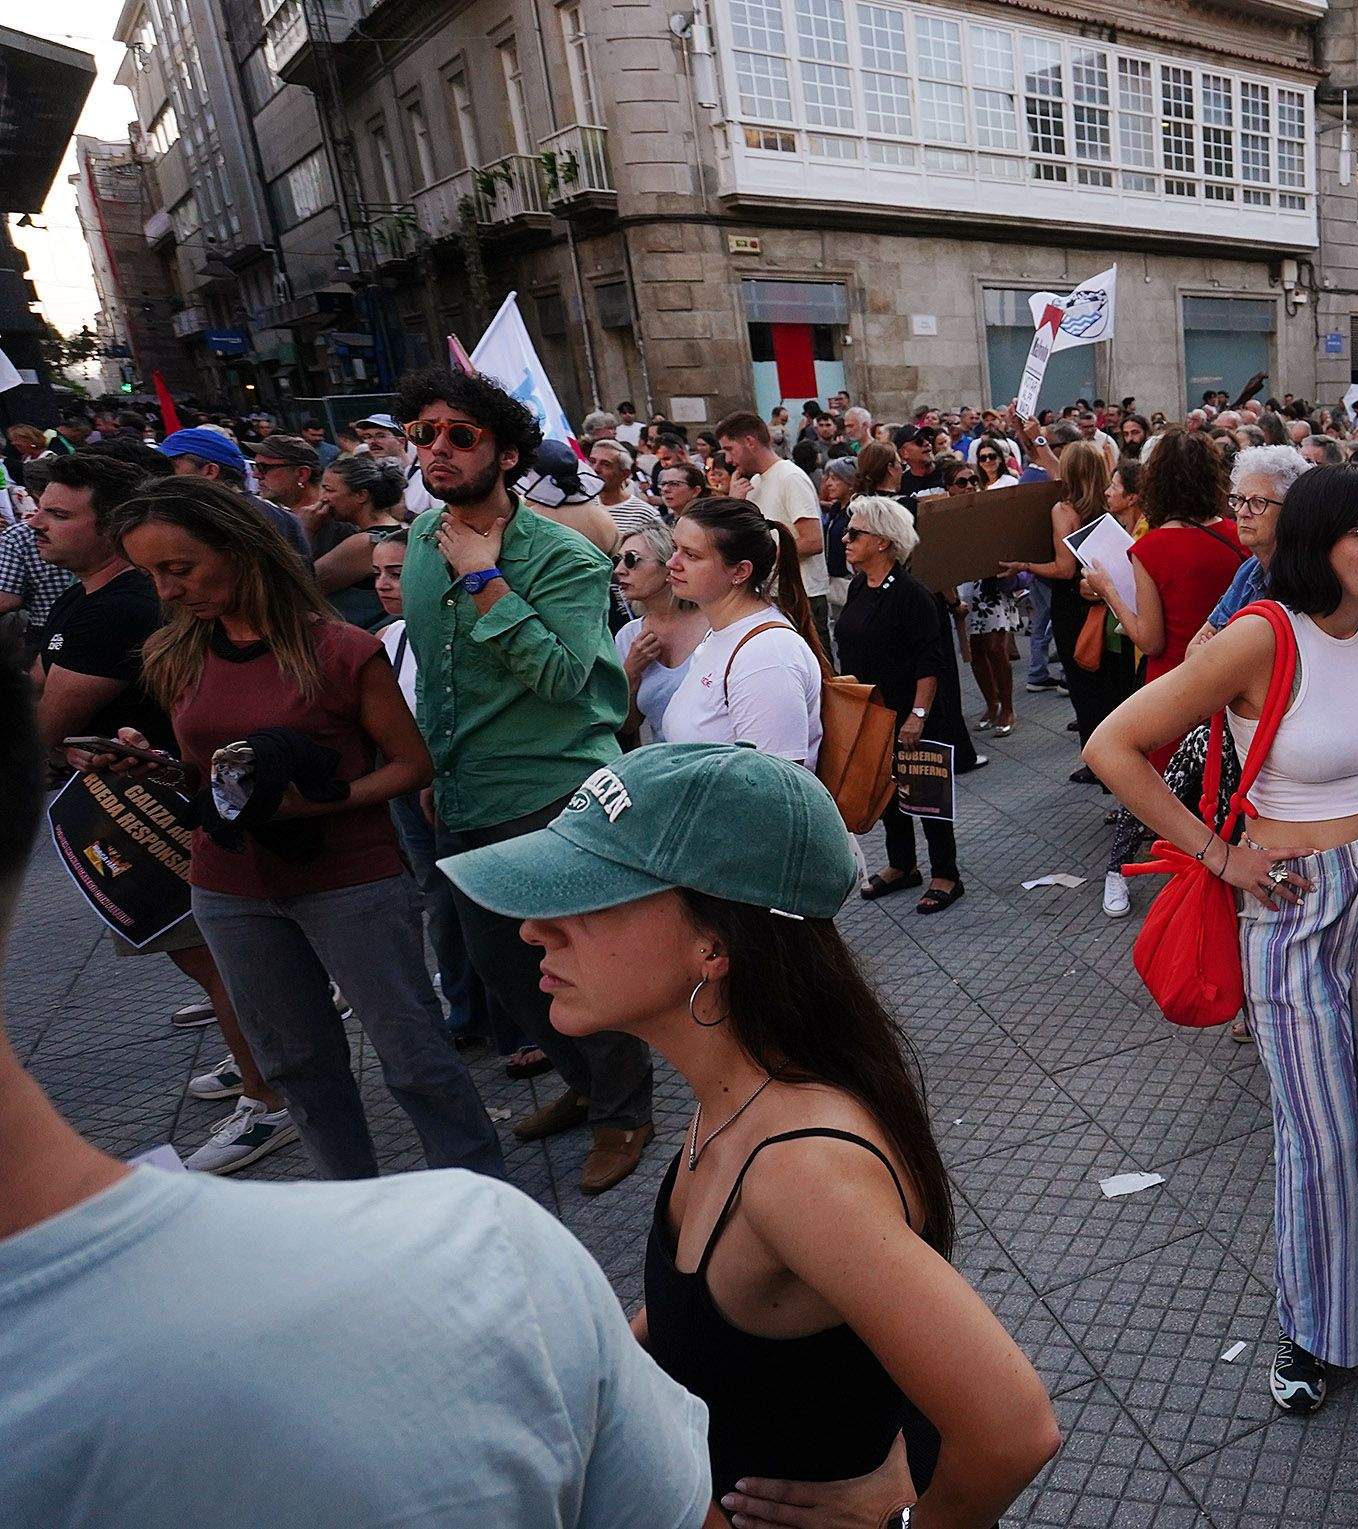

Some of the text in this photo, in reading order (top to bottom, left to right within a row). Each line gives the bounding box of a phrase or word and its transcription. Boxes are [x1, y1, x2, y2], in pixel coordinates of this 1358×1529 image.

[908, 764, 948, 778] INFERNO
[83, 772, 126, 818] RUEDA
[124, 784, 176, 829] GALIZA
